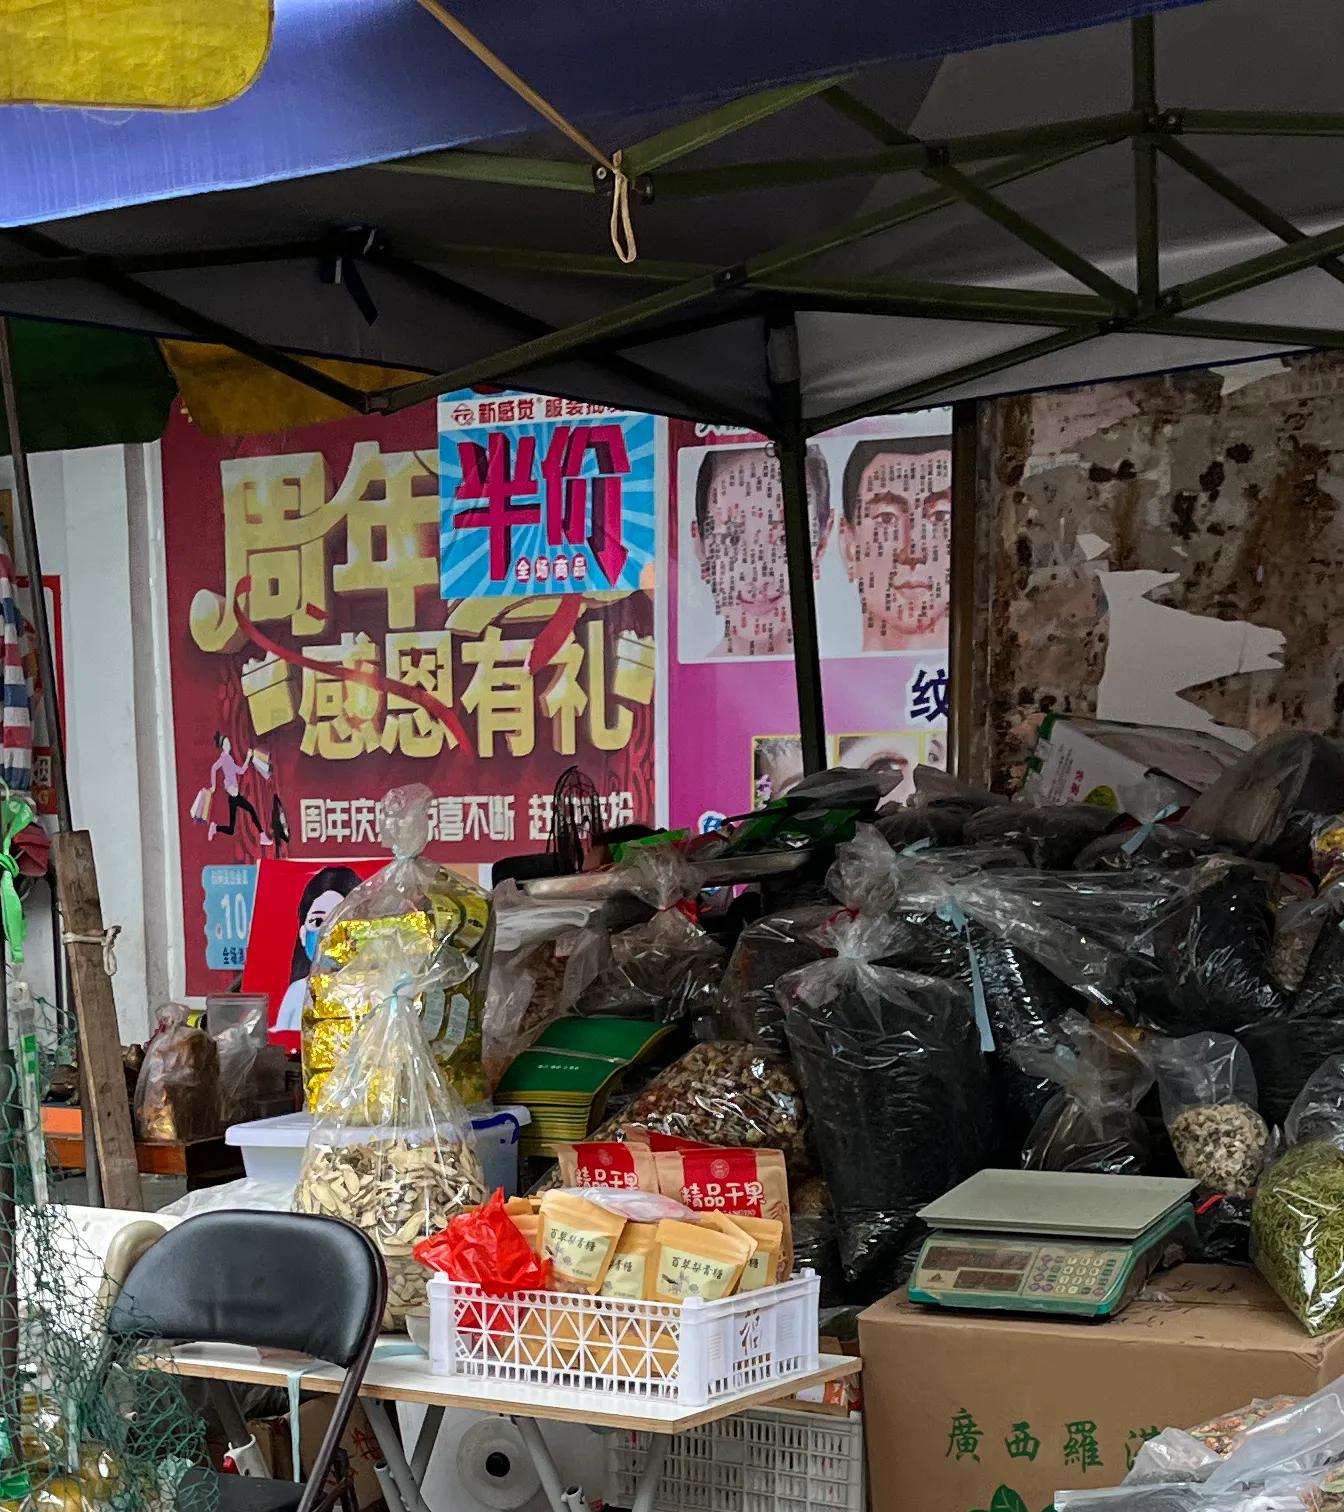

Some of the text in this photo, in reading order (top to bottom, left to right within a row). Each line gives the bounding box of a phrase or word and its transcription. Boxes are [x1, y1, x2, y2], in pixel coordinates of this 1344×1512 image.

[478, 399, 534, 424] 新感觉
[453, 425, 631, 587] 半价
[515, 554, 587, 583] 全场商品
[297, 629, 635, 761] 感恩有礼
[300, 796, 515, 843] 周年庆喜不断
[681, 1182, 766, 1209] 精品干果
